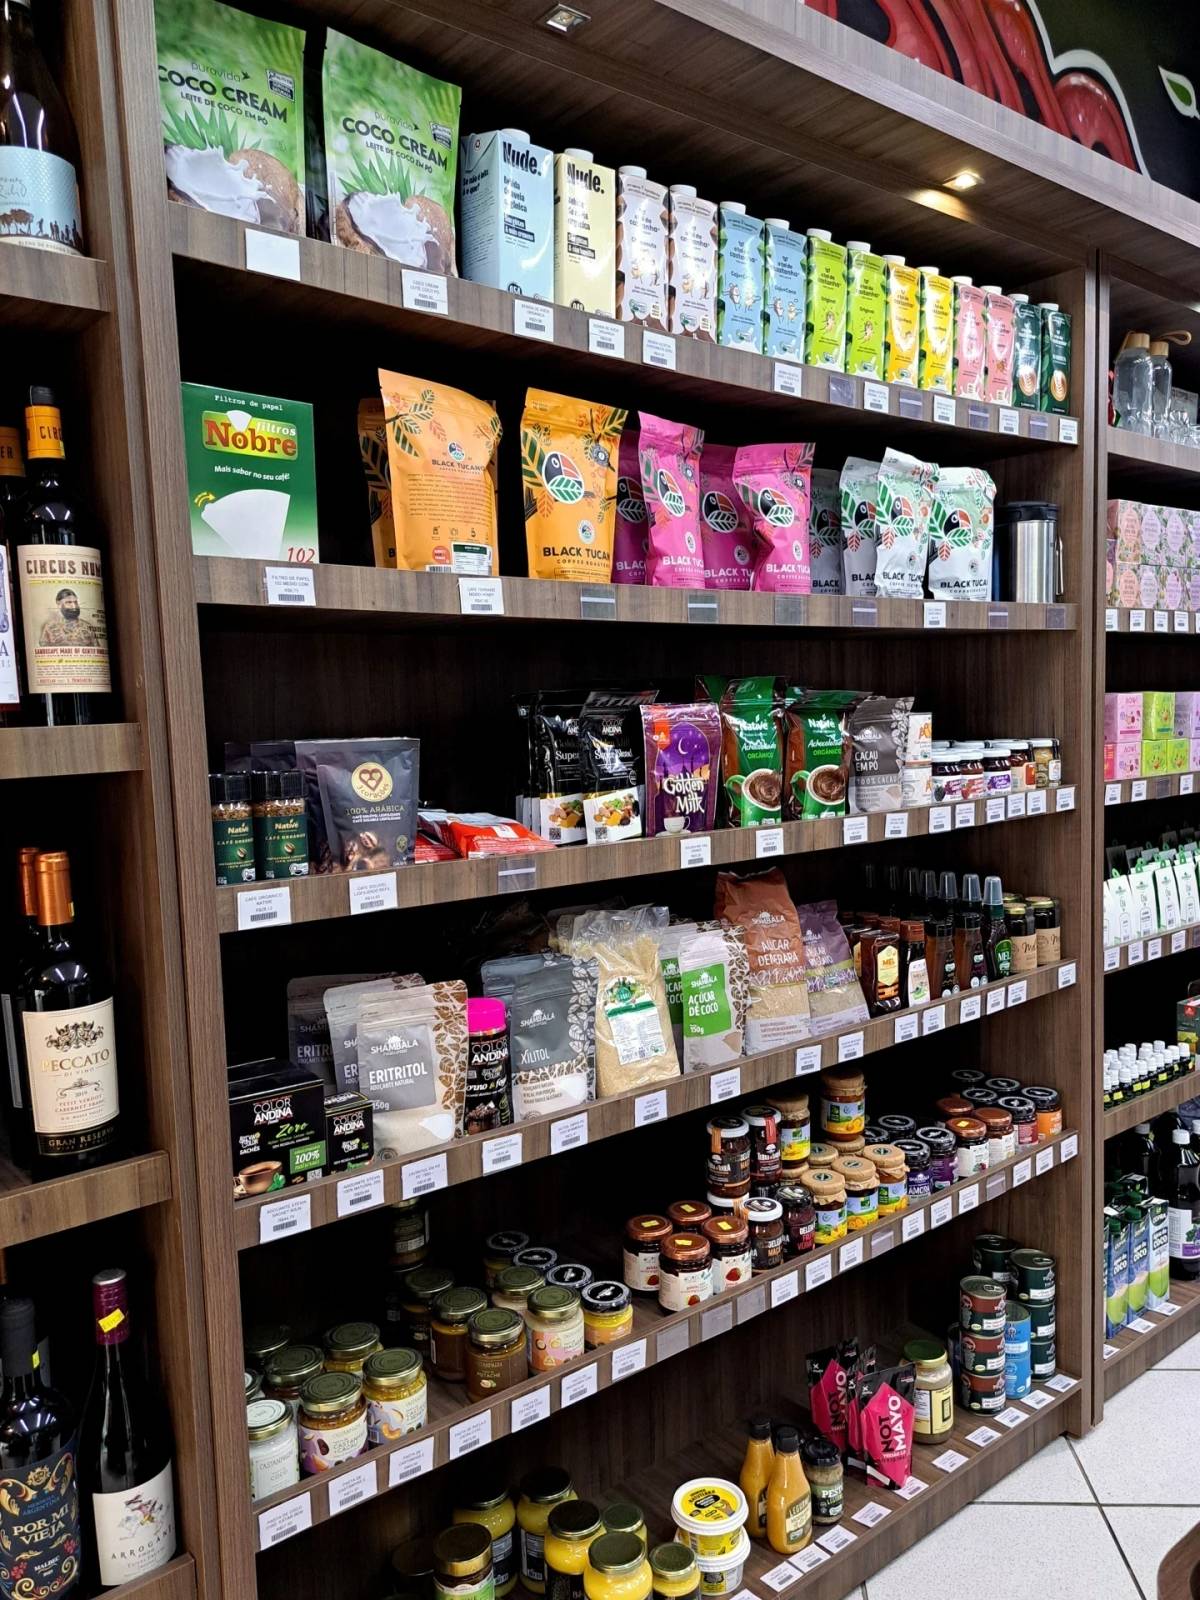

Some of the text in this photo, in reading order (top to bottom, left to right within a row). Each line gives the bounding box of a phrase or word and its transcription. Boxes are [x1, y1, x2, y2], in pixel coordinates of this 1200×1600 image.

[158, 65, 287, 123] COCO CREAM
[180, 91, 268, 126] LEITE DE COCO EM PÓ
[342, 117, 448, 171] COCO CREAM
[366, 141, 384, 153] LEITE
[385, 147, 395, 156] DE
[396, 150, 415, 163] COCO
[503, 141, 541, 176] Nude.
[567, 162, 605, 194] Nude.
[214, 394, 245, 406] Filtros
[262, 402, 283, 411] papel
[256, 420, 297, 437] filtros
[204, 419, 297, 456] Nobre
[214, 465, 231, 473] Mais
[232, 466, 252, 477] sabor
[253, 471, 262, 479] no
[432, 458, 486, 472] BLACK TUCANO
[287, 547, 315, 563] 102
[543, 547, 582, 557] BLACK
[26, 560, 76, 575] CIRCUS
[663, 556, 692, 566] BLACK
[766, 564, 796, 573] BLACK
[704, 569, 738, 578] BLACK
[882, 571, 905, 580] BLACK
[812, 580, 839, 588] BLACK
[940, 580, 970, 589] BLACK
[855, 750, 878, 761] CACAU
[856, 760, 879, 772] EM PÓ
[662, 775, 705, 795] Golden
[370, 804, 405, 814] ARÁBICA
[675, 796, 705, 814] Milk
[228, 824, 249, 835] Native
[274, 820, 299, 831] Native
[998, 951, 1011, 961] MEL
[688, 989, 716, 1005] AÇÚCAR
[689, 1001, 718, 1016] DE COCO
[520, 1013, 555, 1028] SHAMBALA
[371, 1039, 418, 1054] SHAMBALA
[472, 1037, 507, 1054] COLOR
[41, 1048, 110, 1072] PECCATO
[521, 1048, 550, 1065] XILITOL
[369, 1062, 427, 1084] ERITRITOL
[254, 1098, 291, 1114] COLOR
[254, 1107, 293, 1124] ANDINA
[333, 1112, 363, 1126] COLOR
[276, 1122, 308, 1138] Zero
[334, 1121, 365, 1135] ANDINA
[48, 1137, 76, 1147] GRAN
[295, 1150, 320, 1165] 100%
[888, 1395, 907, 1451] MAYO
[879, 1416, 895, 1452] NOT
[12, 1504, 69, 1536] POR MI
[21, 1522, 65, 1545] VIEJA
[34, 1556, 60, 1571] MALBEC
